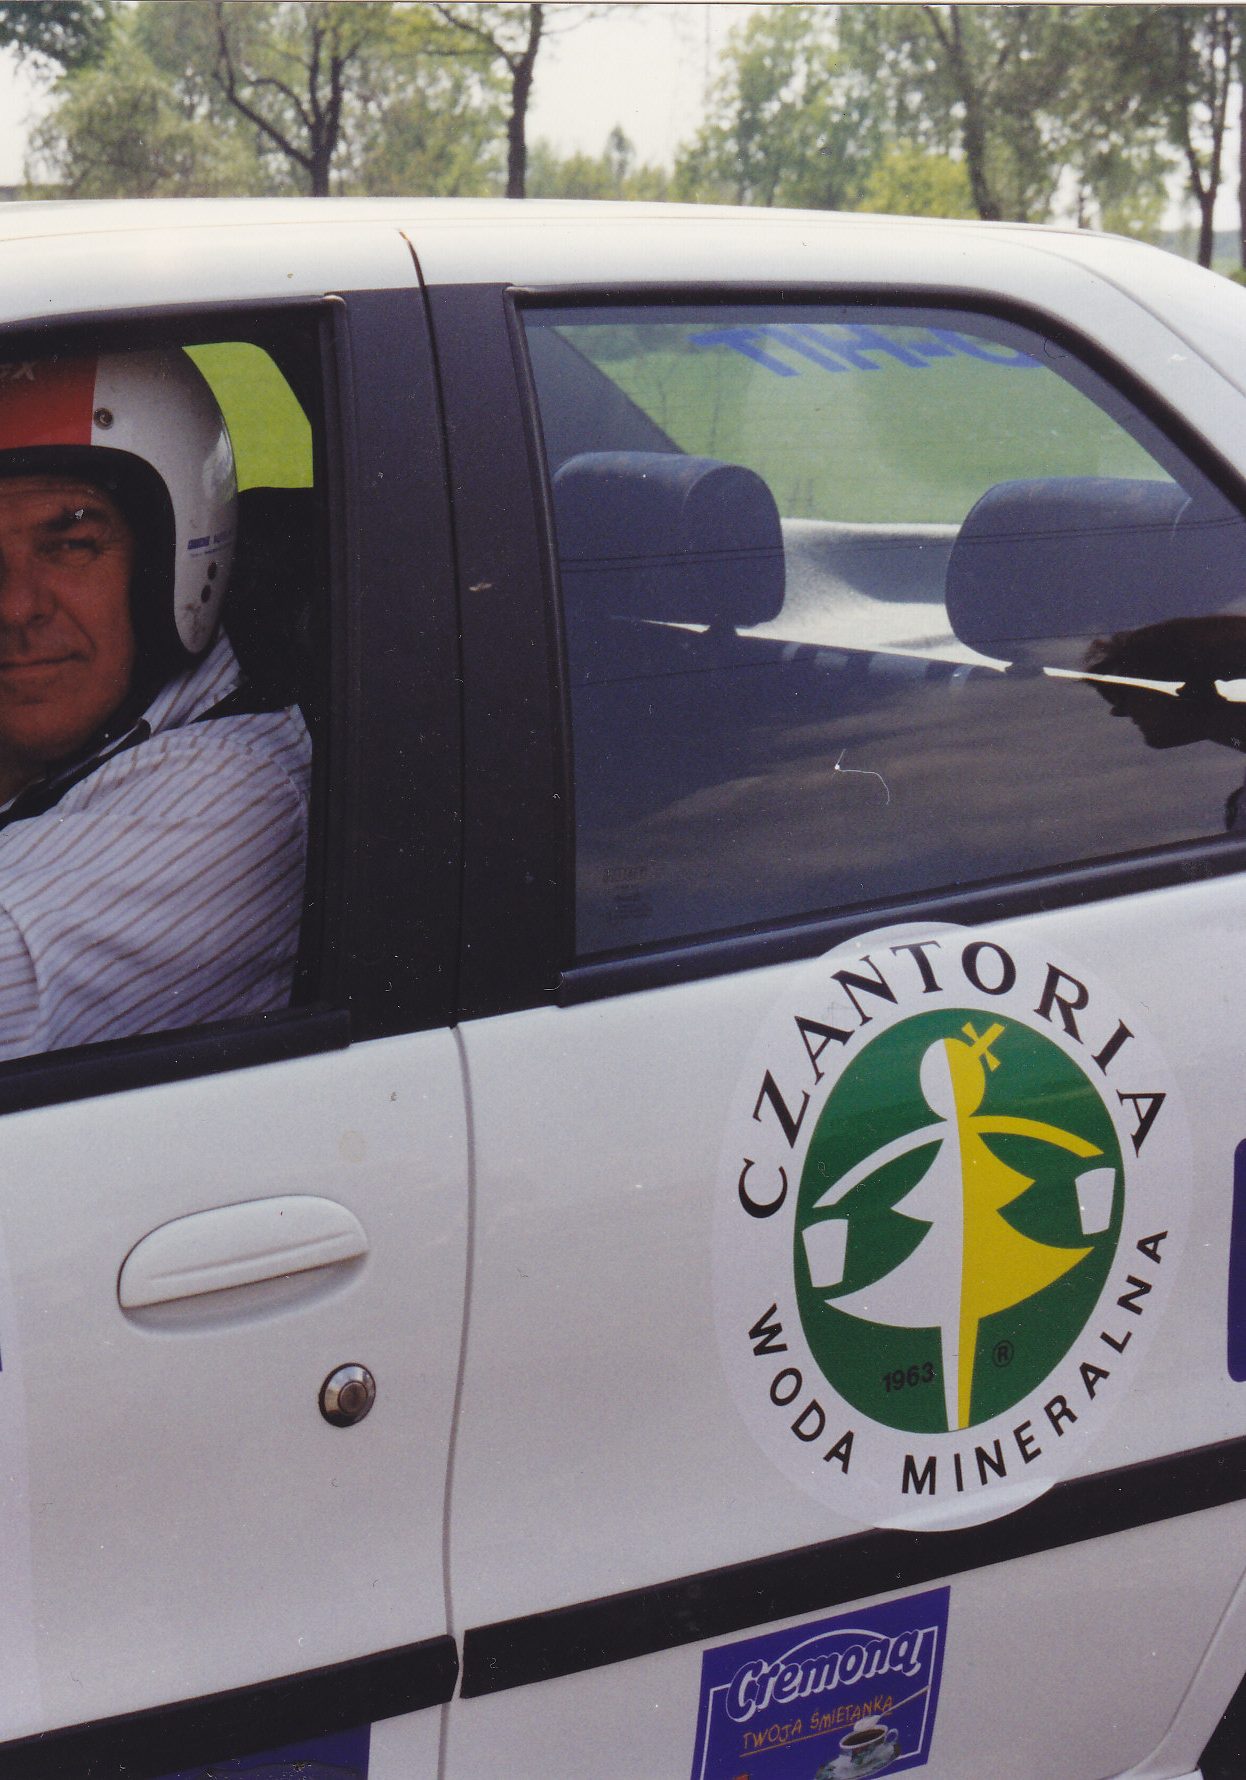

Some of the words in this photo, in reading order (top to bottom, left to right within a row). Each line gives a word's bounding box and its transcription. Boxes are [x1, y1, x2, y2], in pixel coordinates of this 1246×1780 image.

[738, 941, 1166, 1219] CZANTORIA
[748, 1303, 854, 1474] WODA
[901, 1230, 1168, 1496] MINERALNA
[883, 1361, 934, 1393] 1963
[726, 1628, 922, 1723] Cremona
[743, 1719, 802, 1750] TWOJA
[810, 1694, 893, 1730] ŚMIETANKA
